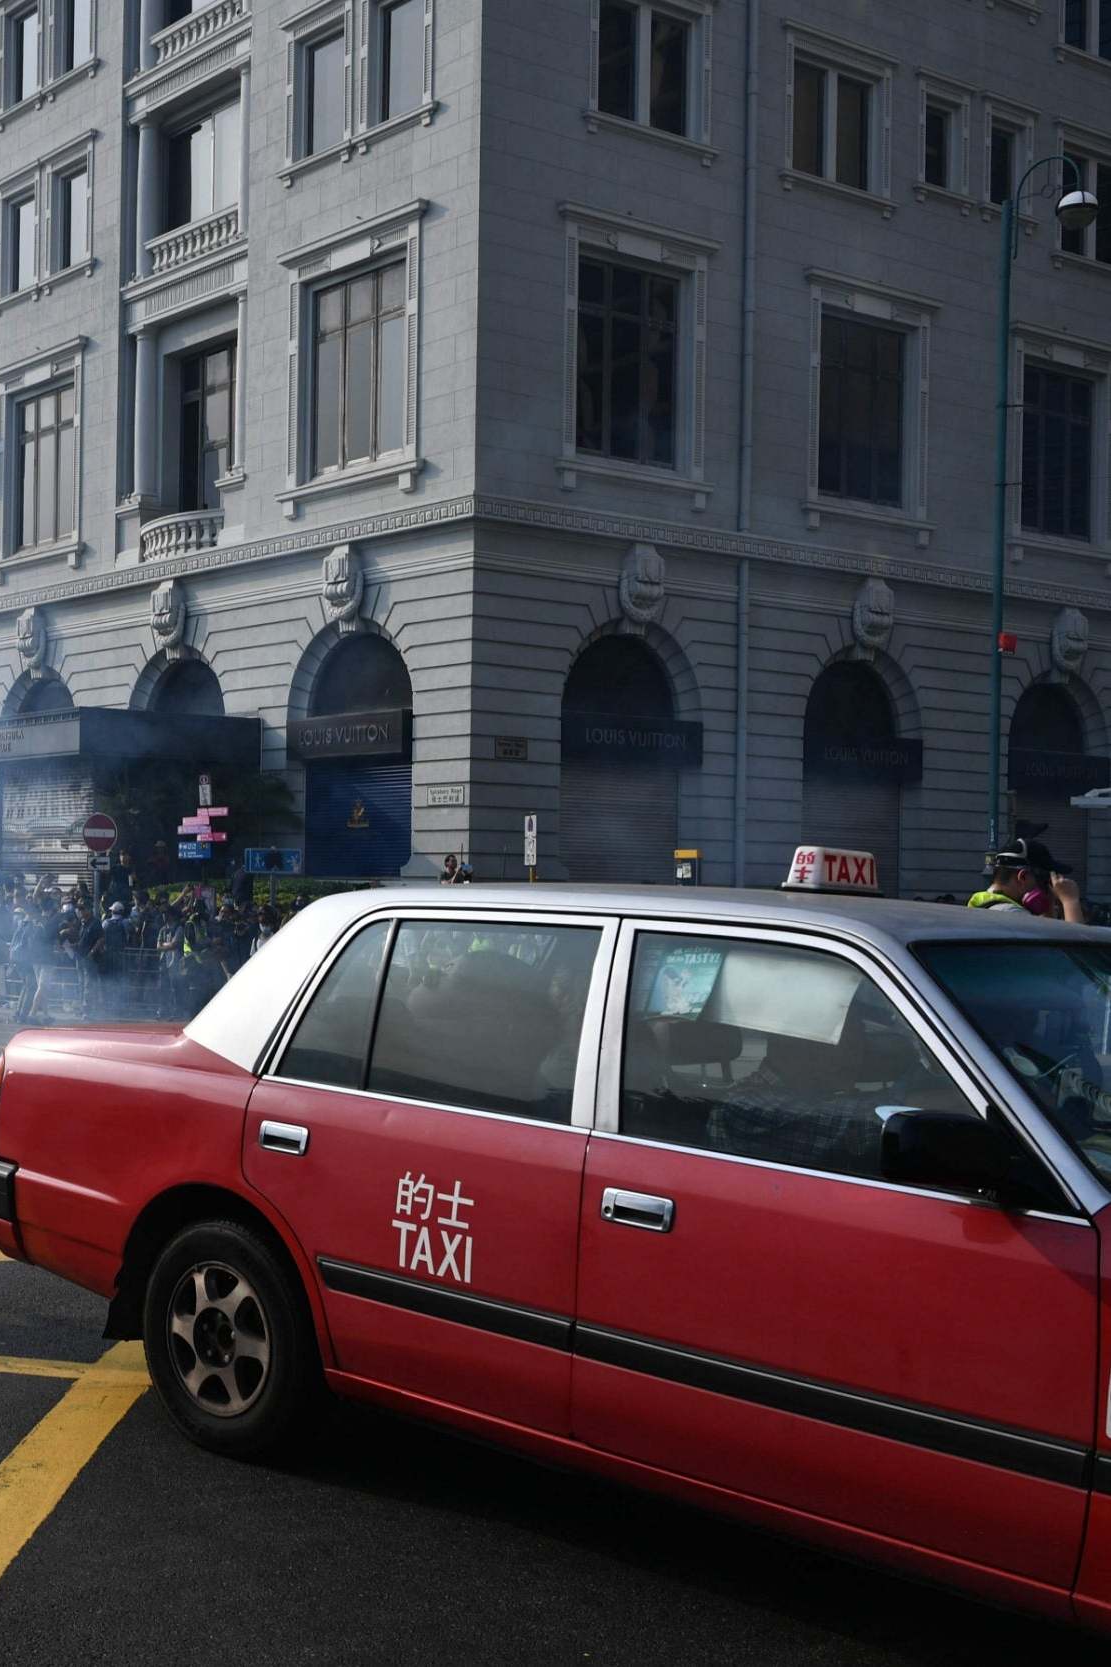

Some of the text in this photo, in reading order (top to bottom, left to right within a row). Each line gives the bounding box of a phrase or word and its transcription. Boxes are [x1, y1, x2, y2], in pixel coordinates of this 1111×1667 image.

[297, 723, 389, 745] LOUIS VUITTON
[585, 727, 687, 751] LOUIS VUITTON
[824, 745, 858, 761] LOUIS
[794, 851, 816, 883] 的士
[824, 854, 874, 885] TAXI
[396, 1171, 474, 1229] 的士
[391, 1219, 473, 1283] TAXI
